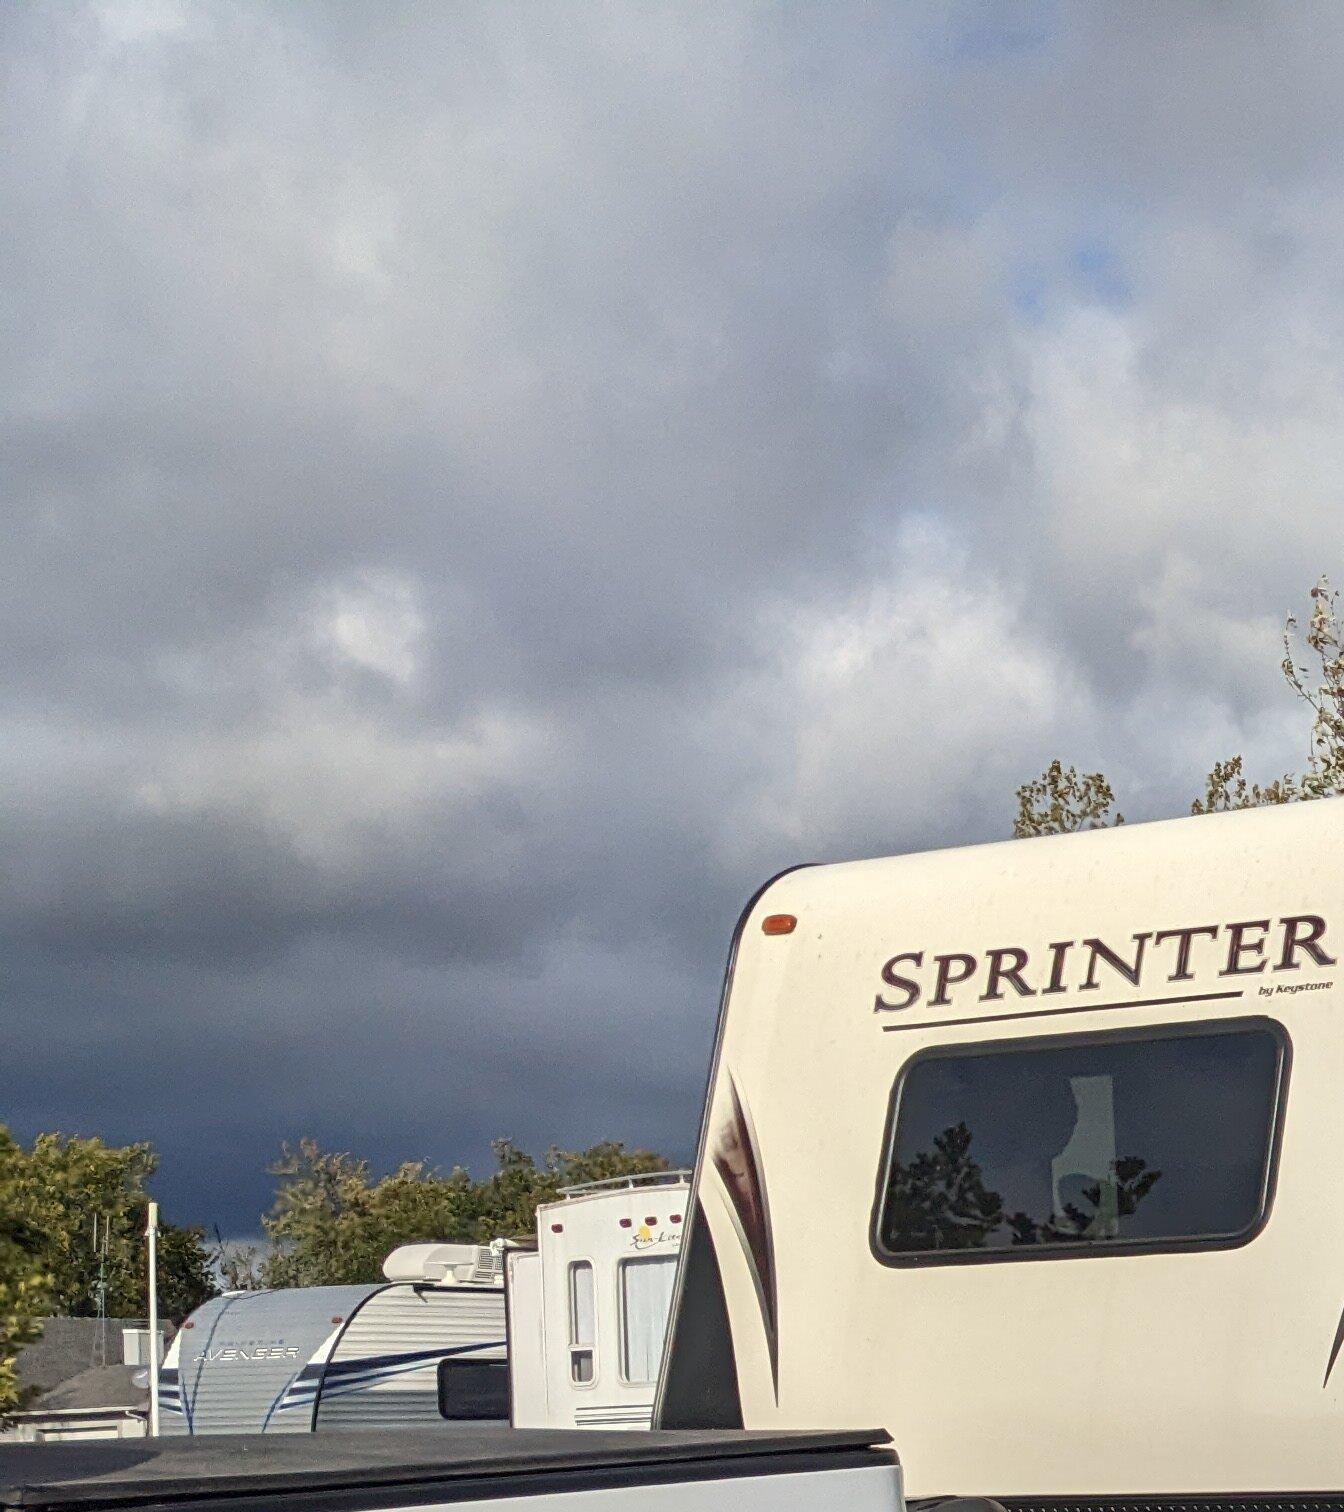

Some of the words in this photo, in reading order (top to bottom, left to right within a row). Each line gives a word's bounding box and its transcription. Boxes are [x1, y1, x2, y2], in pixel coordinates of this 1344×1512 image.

[873, 914, 1337, 1014] SPRINTER
[1258, 986, 1275, 997] by
[1275, 981, 1334, 995] Keystone
